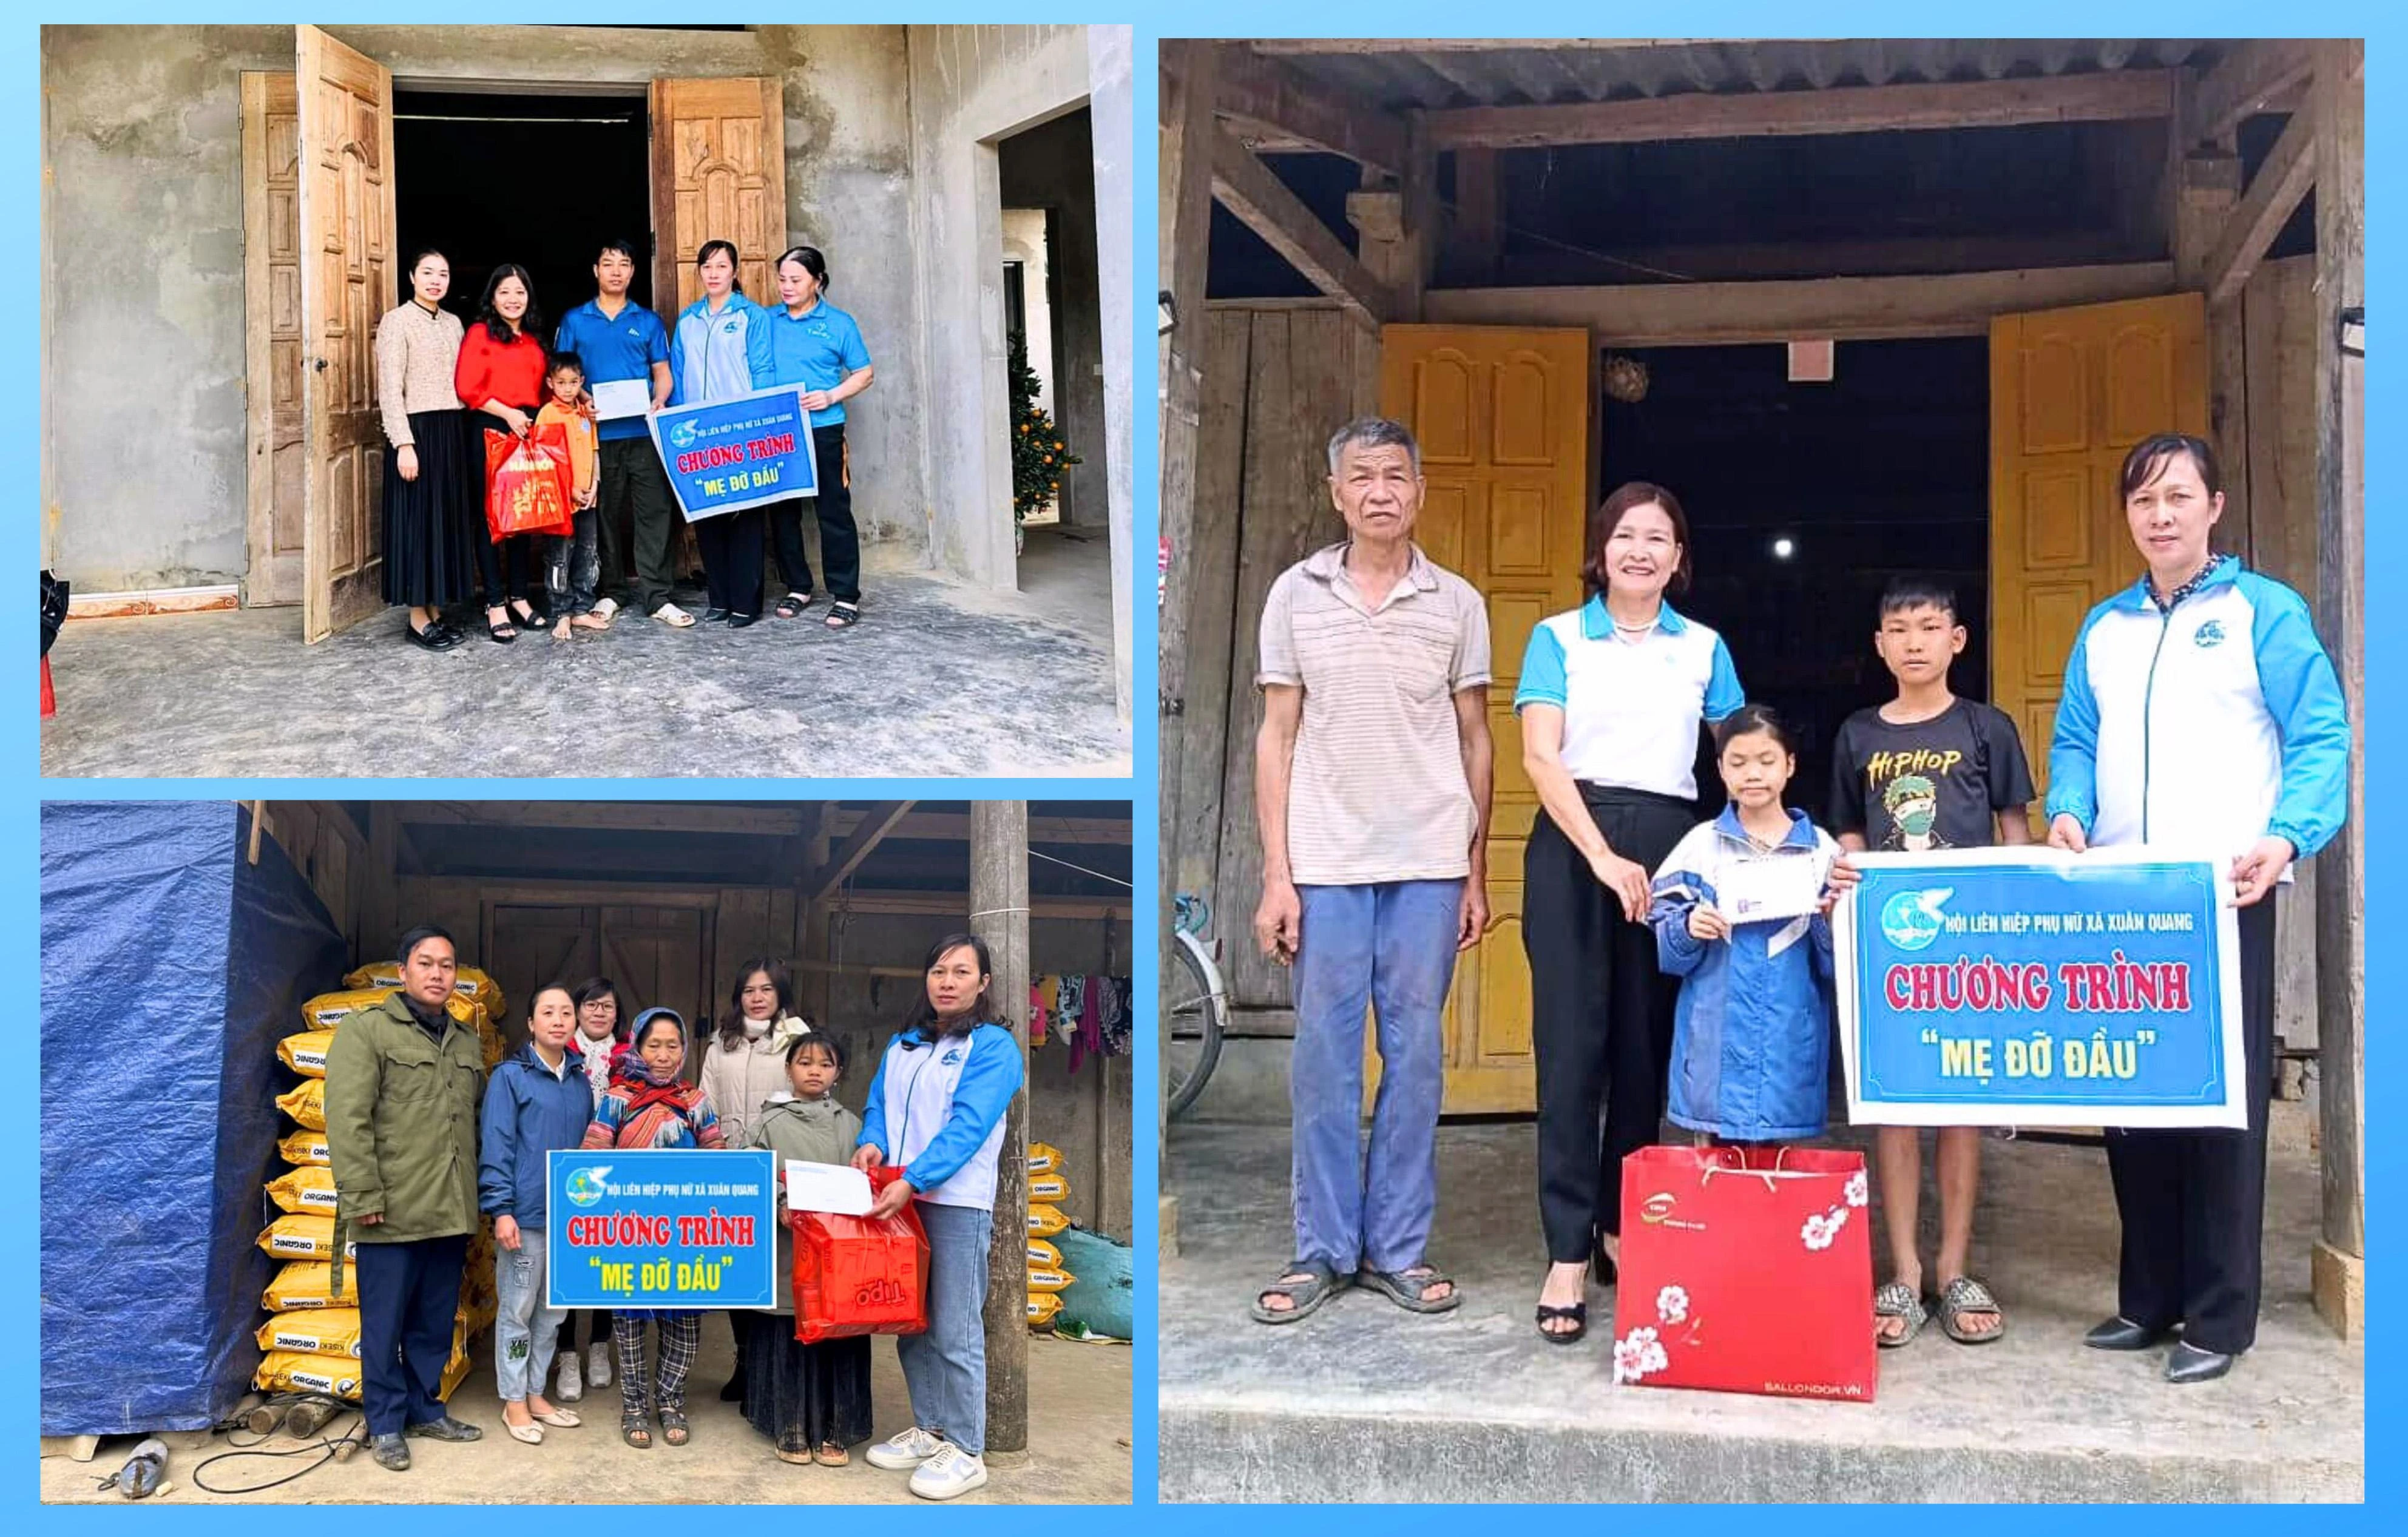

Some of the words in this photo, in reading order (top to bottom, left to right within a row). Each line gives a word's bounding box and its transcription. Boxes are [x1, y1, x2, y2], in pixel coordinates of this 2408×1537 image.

[677, 444, 743, 475] CHƯƠNG
[747, 432, 796, 460] TRÌNH
[729, 471, 749, 492] ĐỠ
[1946, 913, 1966, 936] HỘI
[1970, 911, 1998, 932] LIÊN
[2001, 912, 2030, 936] HIỆP
[2034, 914, 2060, 937] PHỤ
[2064, 911, 2083, 931] NỮ
[2086, 911, 2105, 931] XÃ
[2108, 911, 2144, 931] XUÂN
[2148, 913, 2193, 931] QUANG
[1884, 954, 2049, 1012] CHƯƠNG
[2058, 950, 2191, 1012] TRÌNH
[2005, 1032, 2052, 1078] ĐỠ
[607, 1181, 620, 1199] HỘI
[623, 1182, 640, 1197] LIÊN
[642, 1182, 661, 1199] HIỆP
[663, 1184, 679, 1199] PHỤ
[681, 1182, 694, 1197] NỮ
[708, 1182, 729, 1196] XUÂN
[731, 1184, 759, 1197] QUANG
[567, 1210, 671, 1248] CHƯƠNG
[677, 1207, 755, 1248] TRÌNH
[274, 1239, 313, 1249] ORGANIC
[641, 1258, 671, 1292] ĐỠ
[856, 1278, 907, 1306] Tipo
[276, 1337, 316, 1348] ORGANIC
[293, 1374, 330, 1389] ORGANIC
